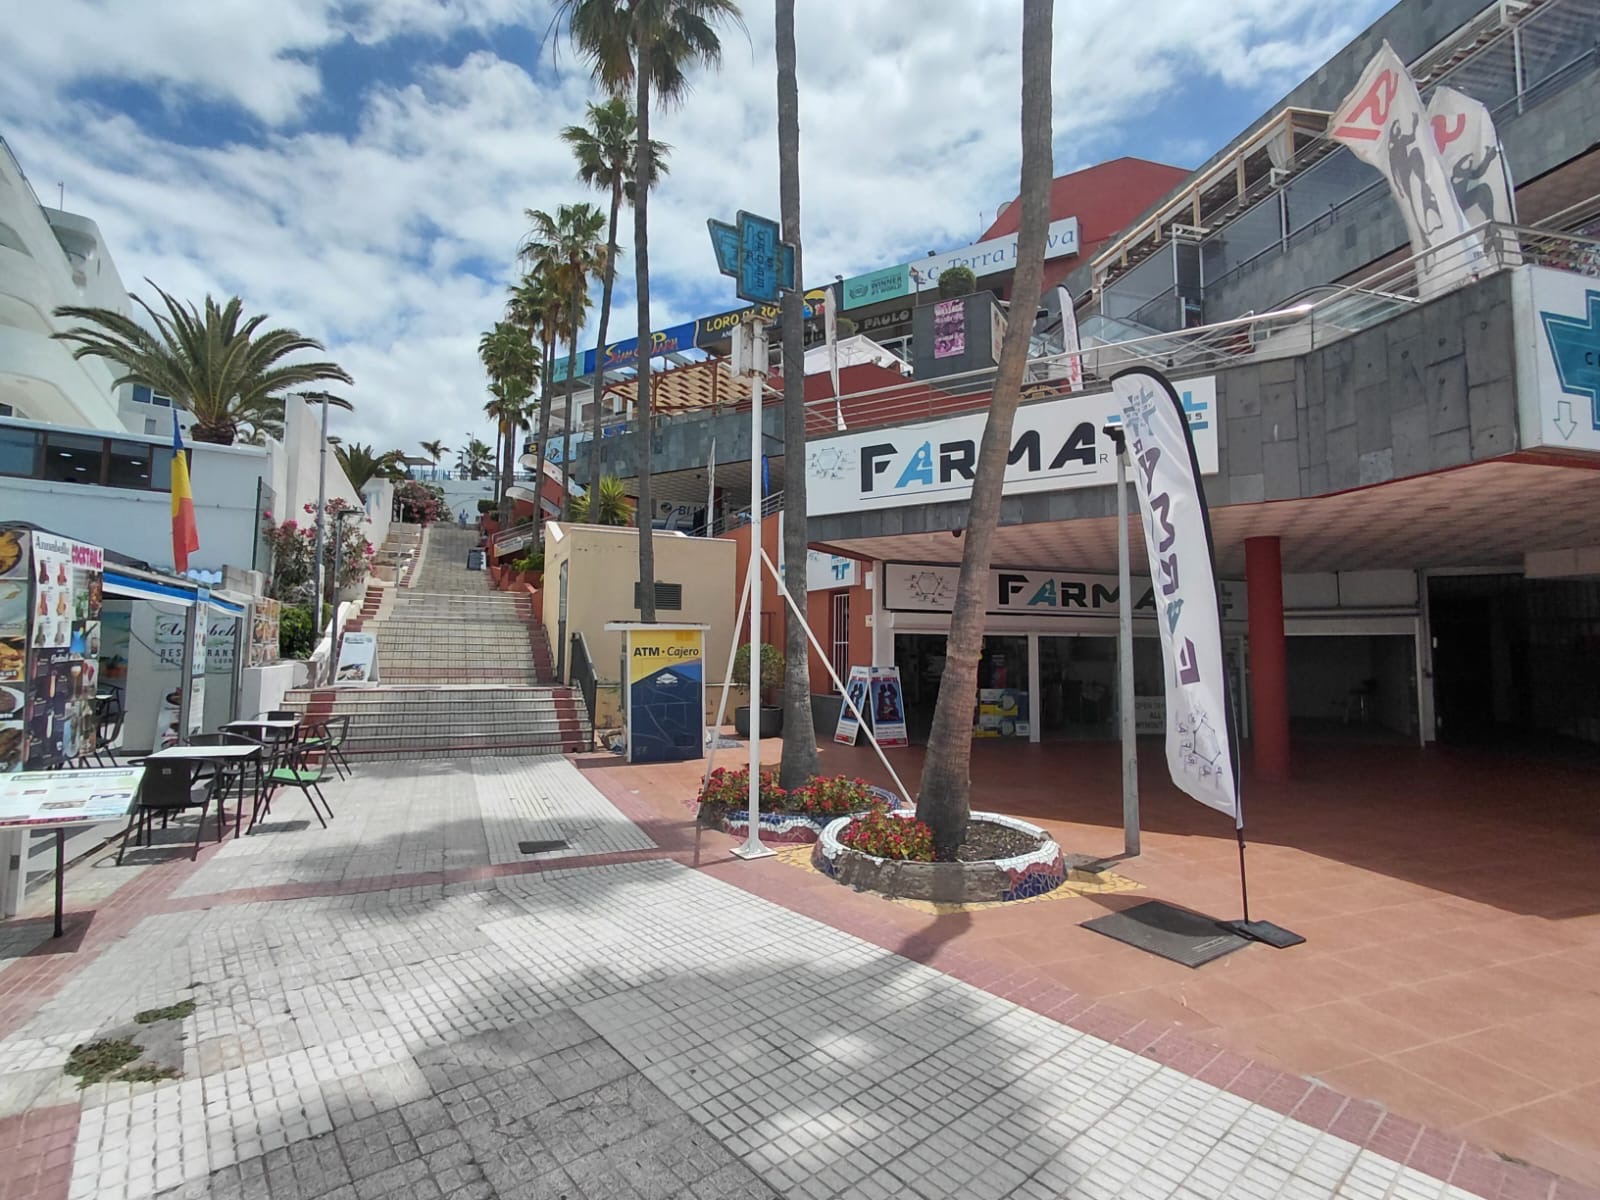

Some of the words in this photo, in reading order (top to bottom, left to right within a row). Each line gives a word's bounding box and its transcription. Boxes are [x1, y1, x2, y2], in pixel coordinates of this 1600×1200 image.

[706, 313, 739, 332] LORO
[864, 310, 909, 328] PAULO
[633, 647, 660, 657] ATM
[666, 646, 699, 658] Cajero
